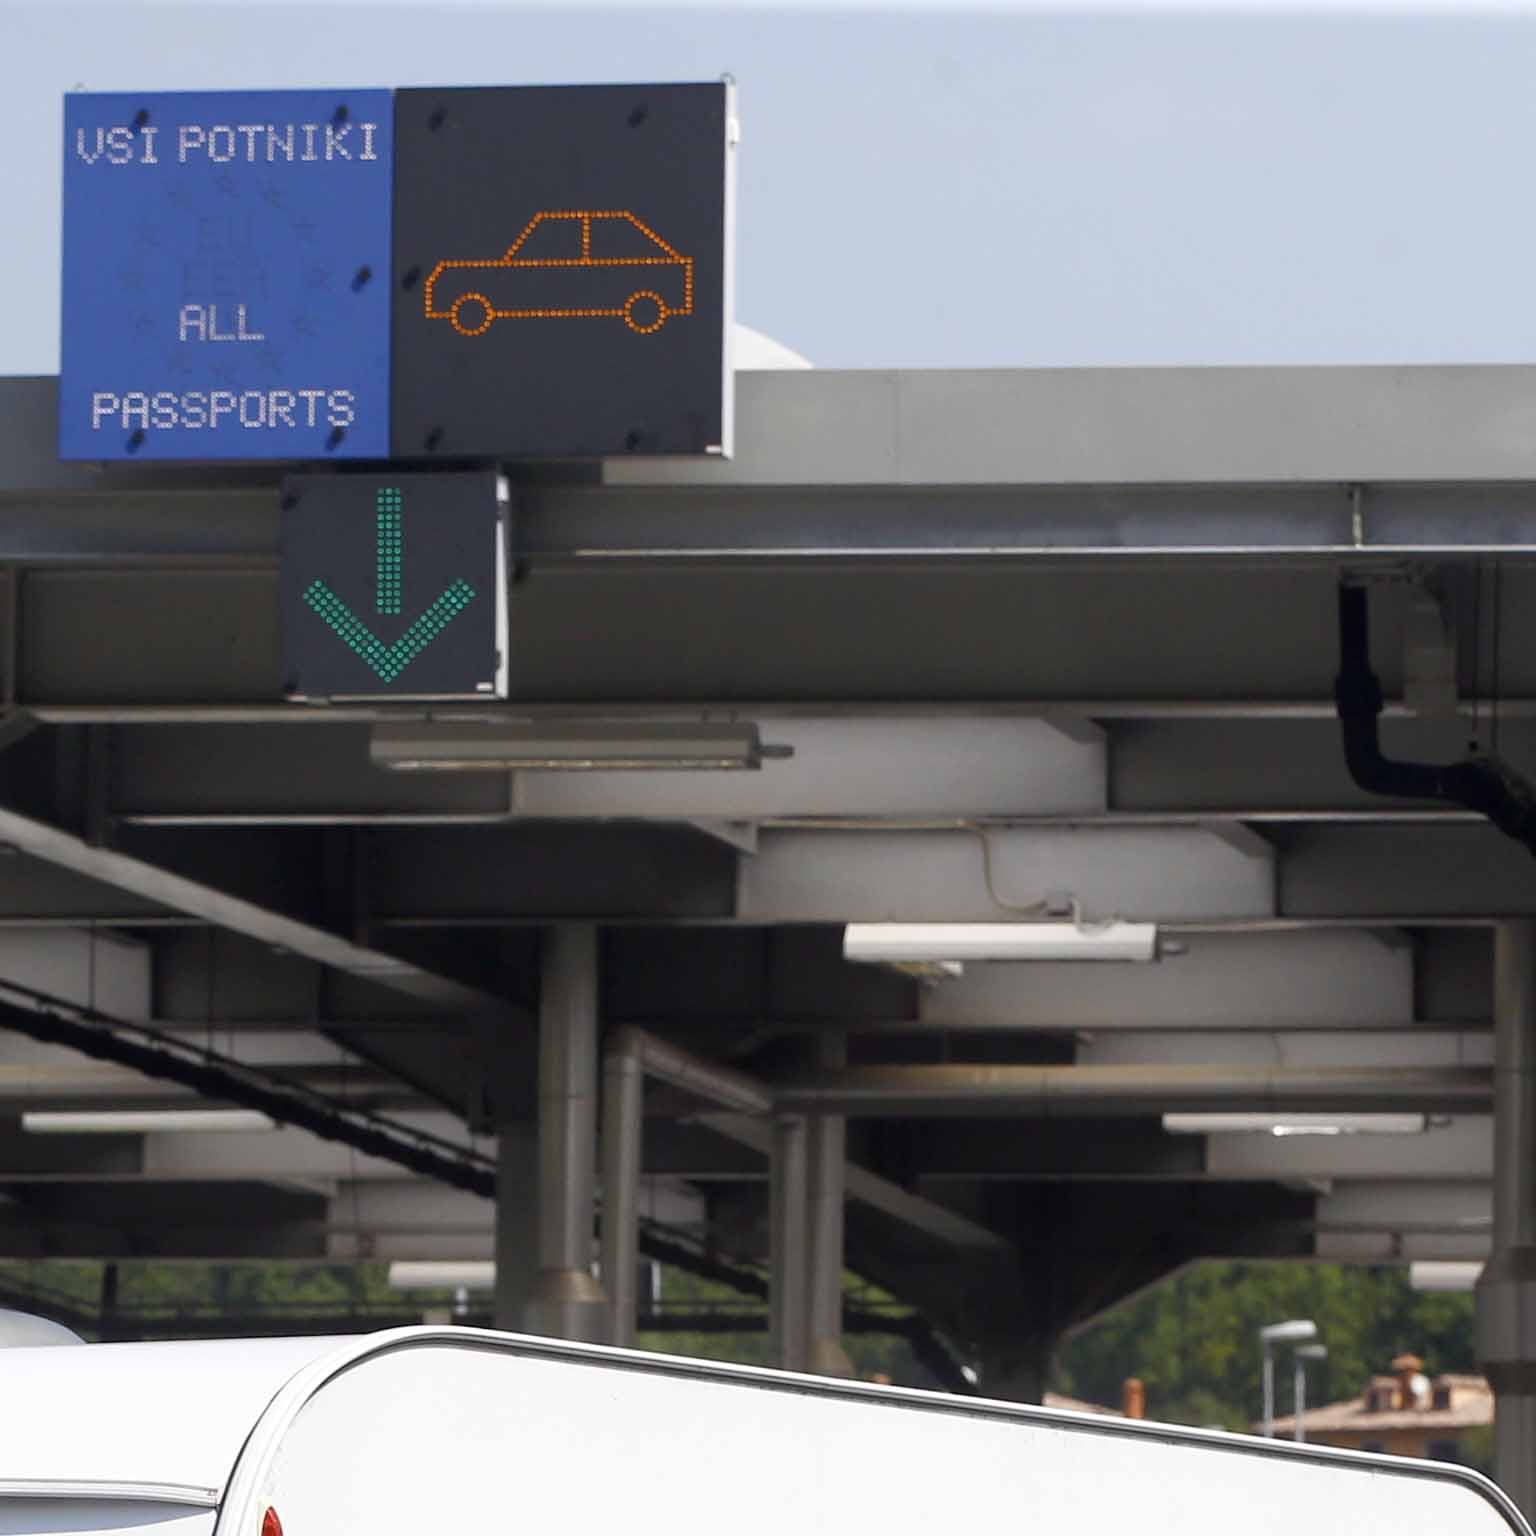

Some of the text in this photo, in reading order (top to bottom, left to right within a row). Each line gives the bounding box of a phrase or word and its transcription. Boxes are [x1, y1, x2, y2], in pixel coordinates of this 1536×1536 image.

[76, 123, 378, 165] VSI POTNIKI
[178, 303, 265, 343] ALL
[92, 389, 356, 429] PASSPORTS
